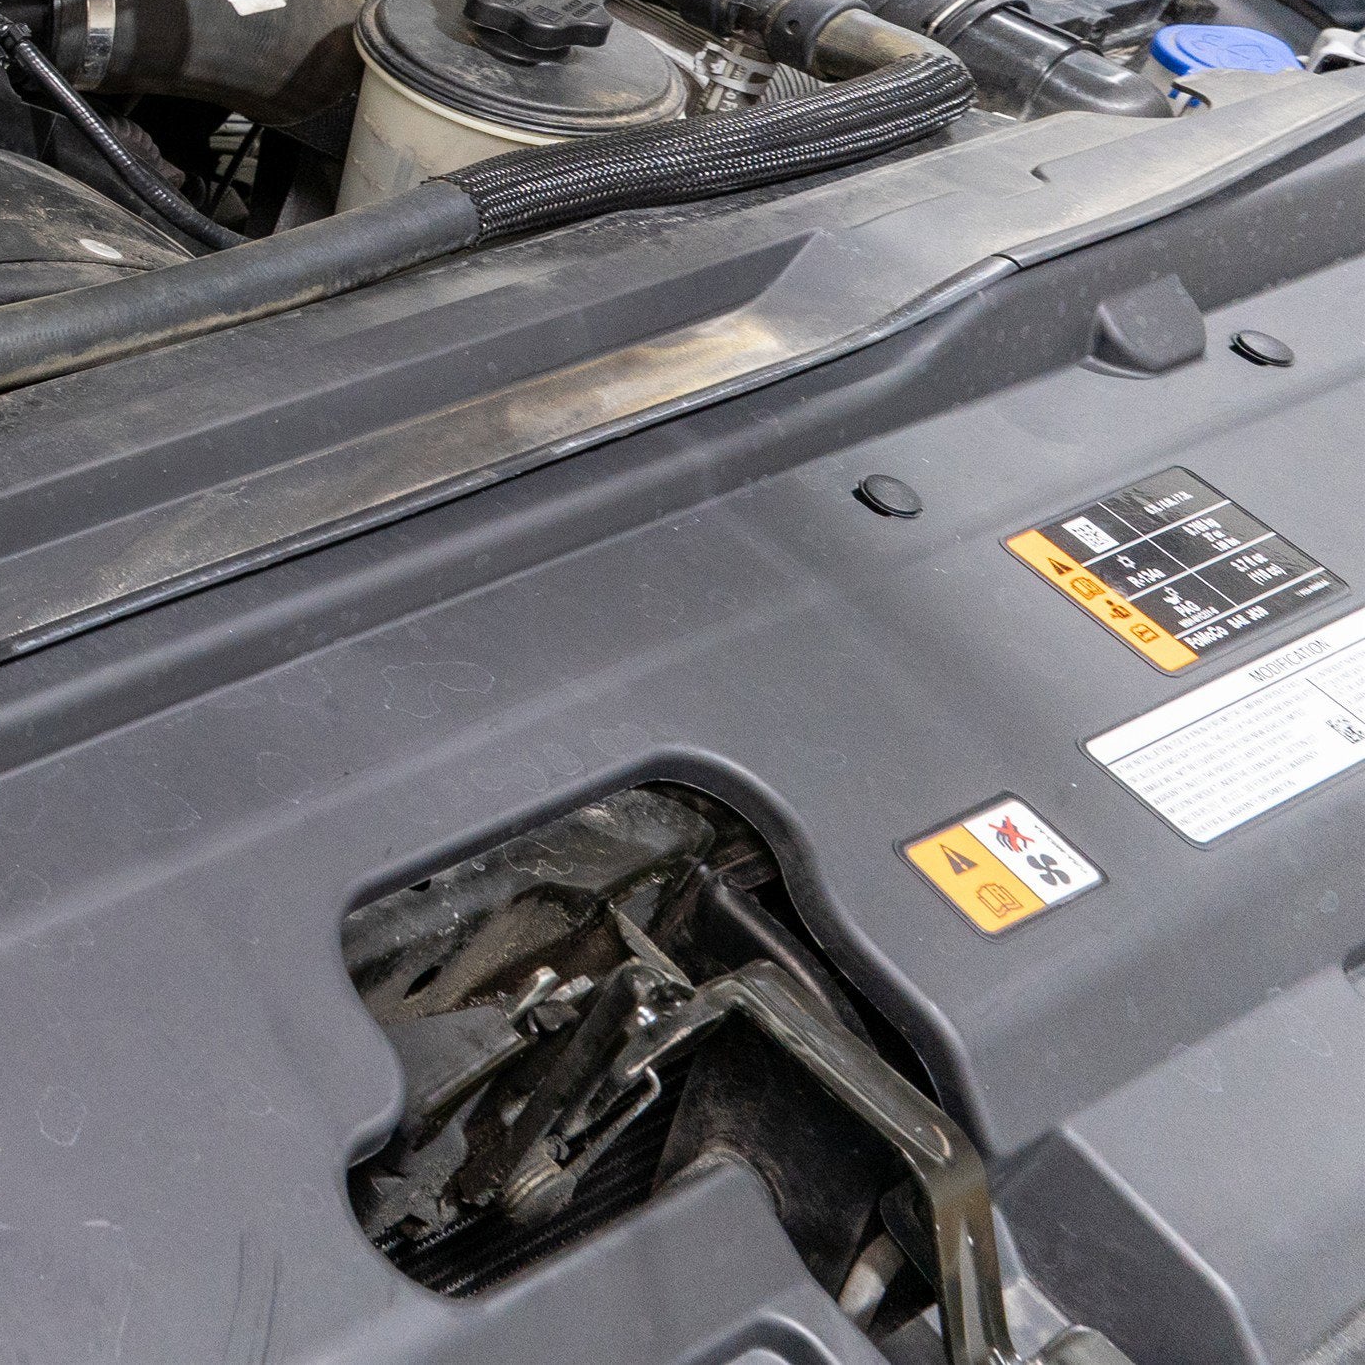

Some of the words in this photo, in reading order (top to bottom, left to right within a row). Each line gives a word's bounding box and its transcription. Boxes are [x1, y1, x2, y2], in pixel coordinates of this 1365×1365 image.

[1173, 600, 1200, 617] PAG
[1184, 625, 1228, 648] FoMoCo
[1249, 640, 1329, 681] MODIFICATION
